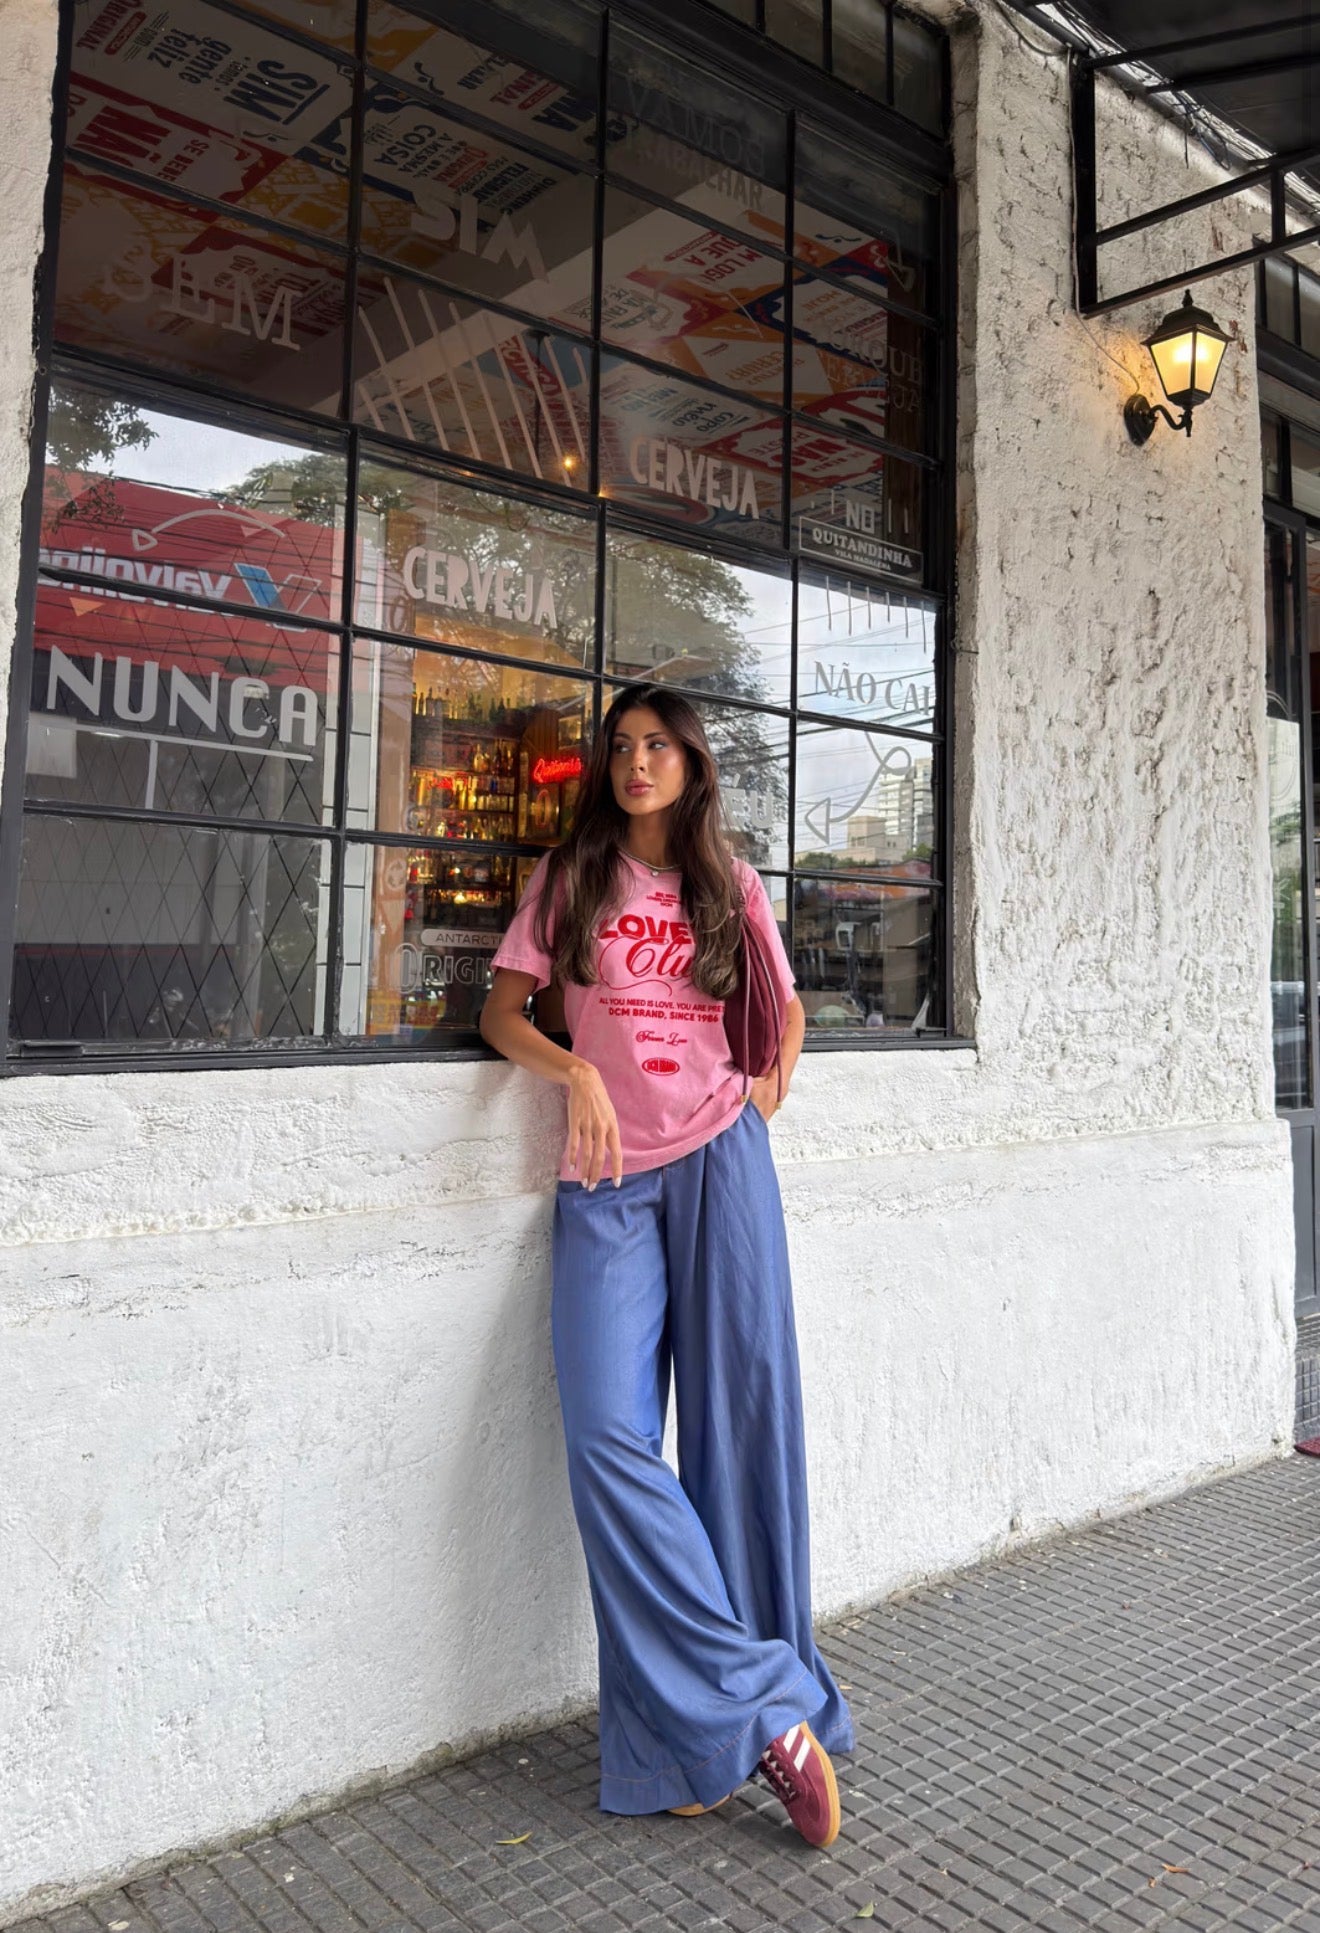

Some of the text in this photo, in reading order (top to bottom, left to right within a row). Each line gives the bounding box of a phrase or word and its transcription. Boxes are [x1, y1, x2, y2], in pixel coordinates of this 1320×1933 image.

[149, 28, 202, 70] feliz
[178, 37, 232, 85] gente
[223, 60, 318, 122] SIM
[156, 153, 195, 182] BEBE
[374, 124, 436, 166] COISA
[630, 435, 759, 520] CERVEJA
[812, 528, 913, 569] QUITANDINHA
[403, 546, 558, 629] CERVEJA
[46, 645, 318, 747] NUNCA
[814, 661, 931, 716] NÃO CAI
[720, 773, 774, 828] ÉU
[436, 933, 505, 945] ANTARCTI
[600, 934, 694, 985] Clu
[394, 943, 490, 994] ORIGI
[609, 1007, 719, 1023] DCM BRAND, SINCE 1986
[610, 998, 625, 1006] YOU
[626, 998, 646, 1007] NEED
[677, 1002, 691, 1010] YOU
[692, 1003, 707, 1012] ARE
